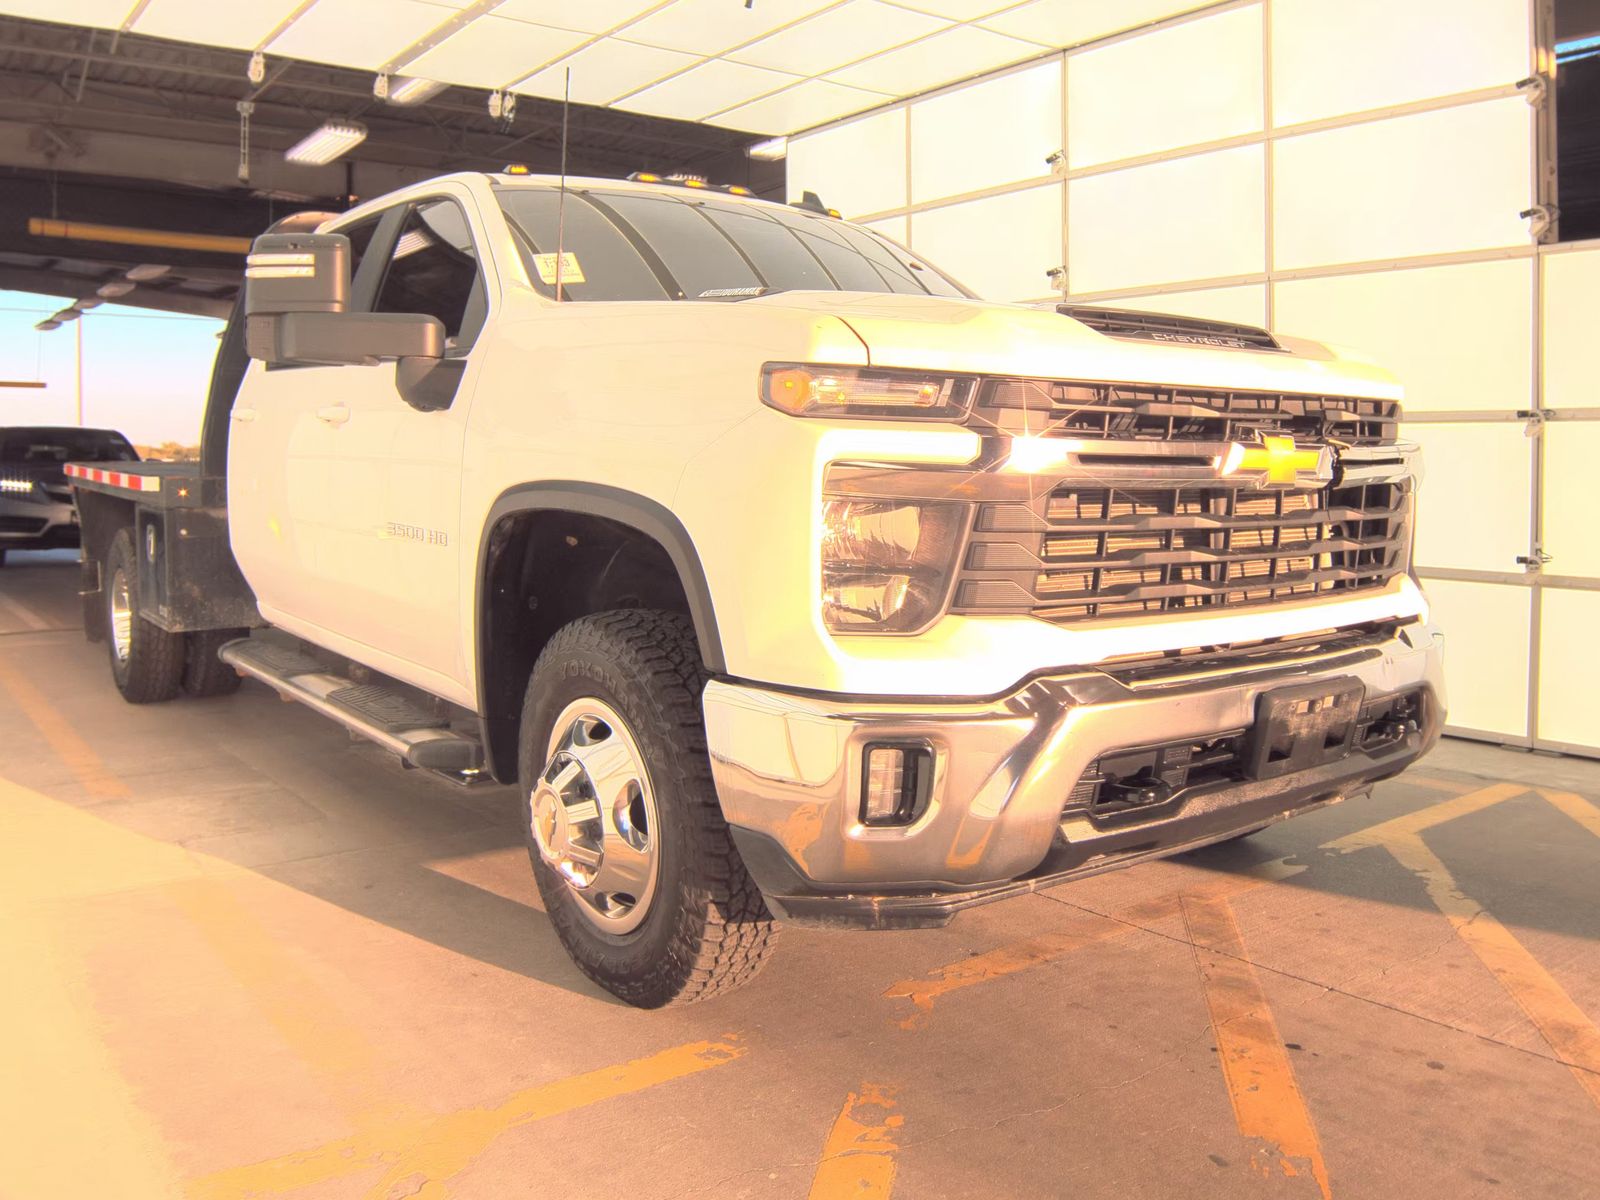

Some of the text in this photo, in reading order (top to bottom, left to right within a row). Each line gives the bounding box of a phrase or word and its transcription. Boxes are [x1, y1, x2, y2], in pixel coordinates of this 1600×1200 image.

[1152, 333, 1245, 348] CHEVROLET
[387, 521, 448, 547] 3500 HD
